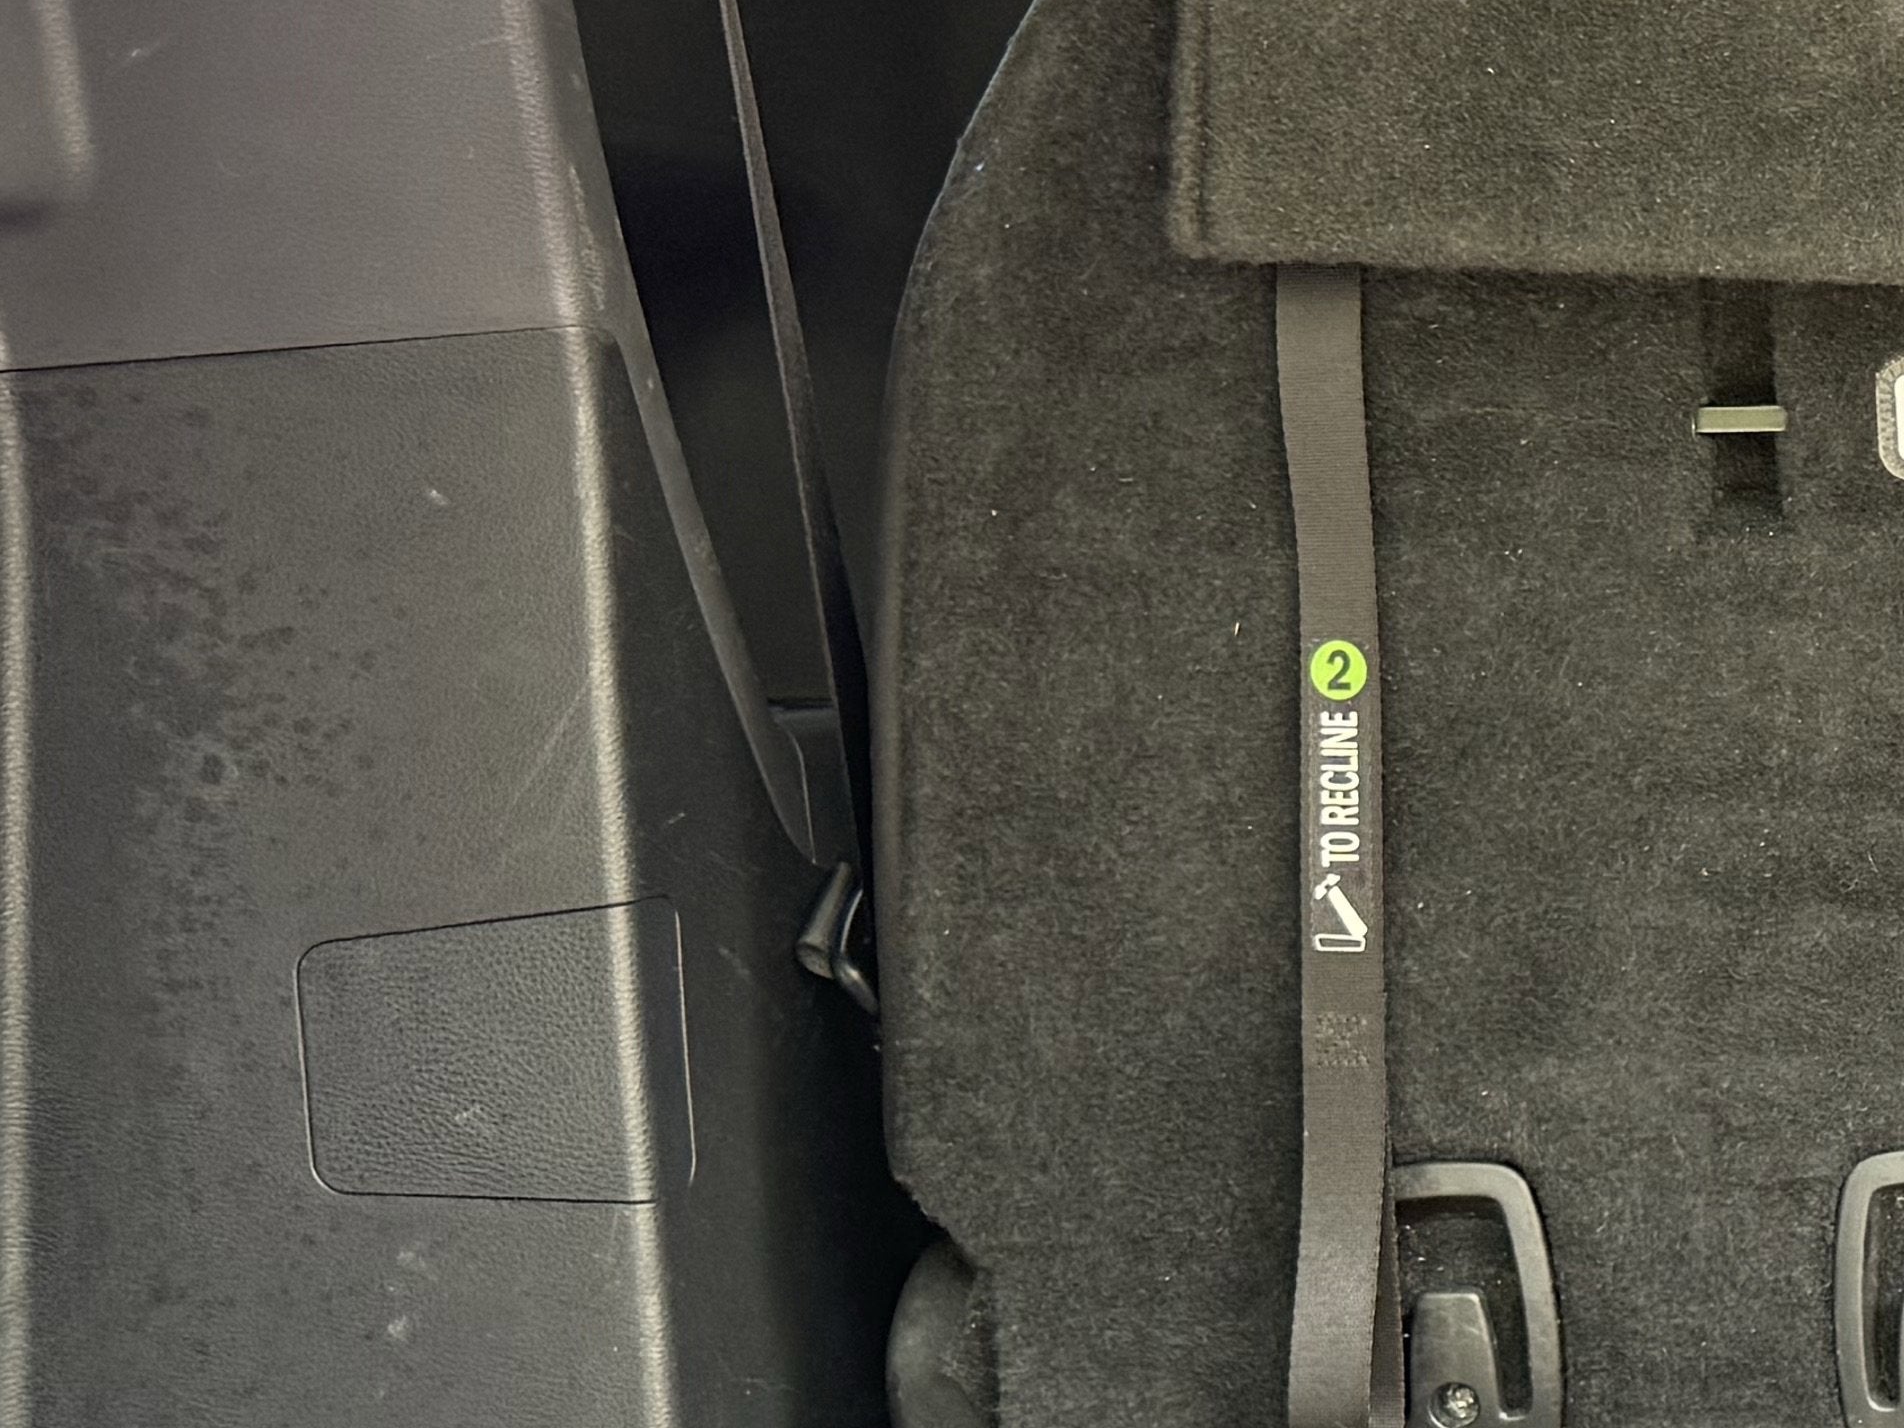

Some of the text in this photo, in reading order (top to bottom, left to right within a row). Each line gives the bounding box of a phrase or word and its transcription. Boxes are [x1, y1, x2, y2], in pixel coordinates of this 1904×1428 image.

[1327, 649, 1351, 690] 2
[1320, 711, 1360, 868] TO RECLINE
